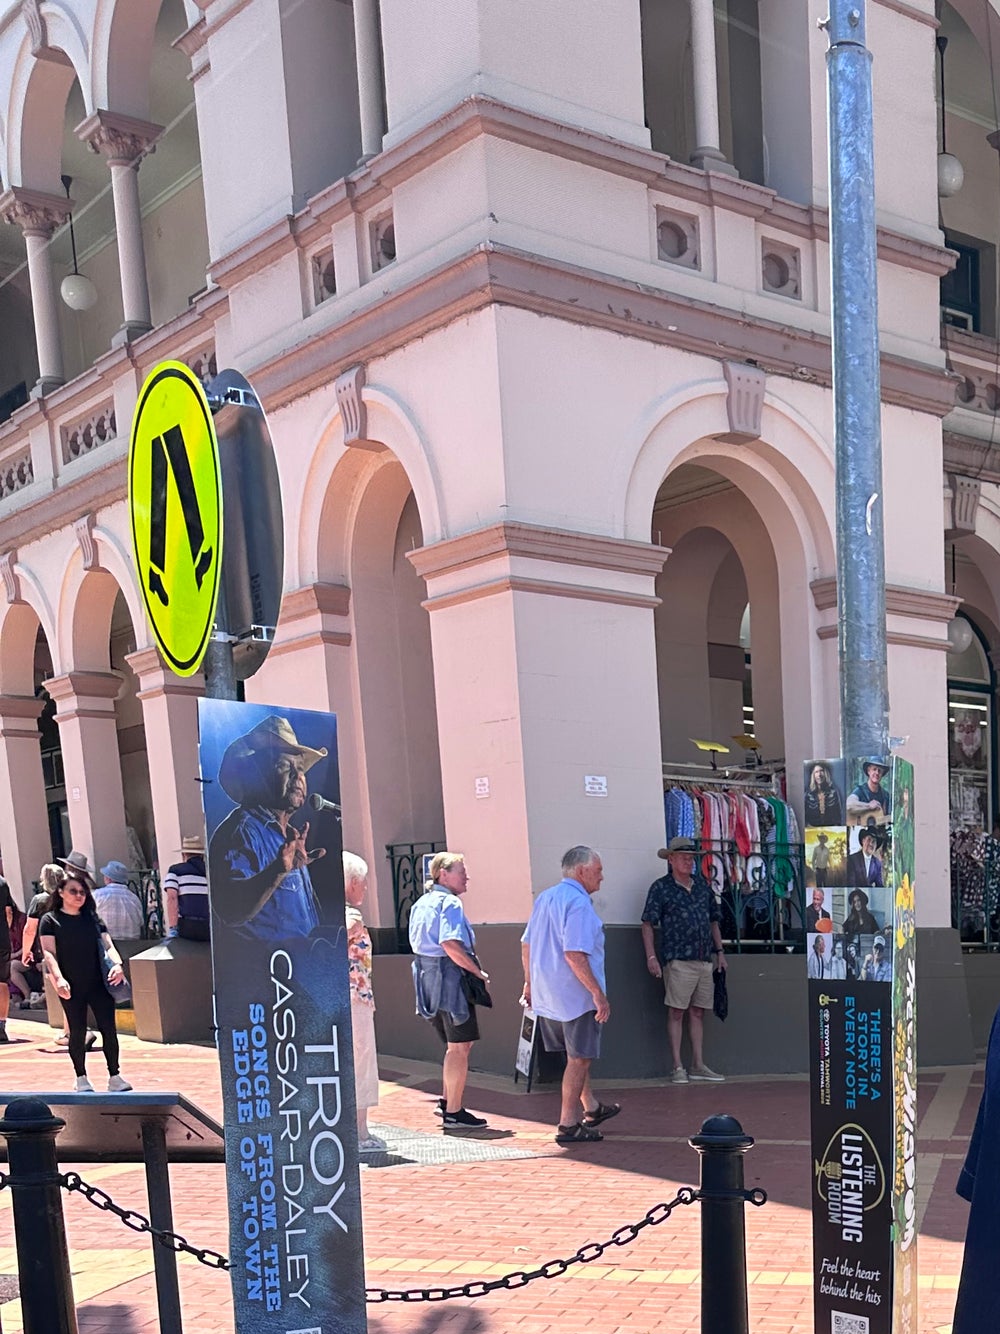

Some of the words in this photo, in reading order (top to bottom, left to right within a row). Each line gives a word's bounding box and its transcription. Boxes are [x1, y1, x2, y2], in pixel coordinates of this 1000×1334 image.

[845, 996, 856, 1058] EVERY
[857, 1011, 868, 1073] STORY
[870, 1008, 881, 1084] THERE'S
[231, 1028, 254, 1124] EDGE
[249, 1002, 270, 1120] SONGS
[845, 1060, 856, 1110] NOTE
[858, 1076, 868, 1096] IN
[870, 1087, 881, 1101] A
[269, 948, 312, 1309] CASSAR-DALEY
[303, 1024, 348, 1234] TROY
[240, 1138, 257, 1182] OF
[257, 1132, 278, 1232] FROM
[841, 1133, 863, 1243] LISTENING
[864, 1163, 876, 1186] THE
[827, 1181, 842, 1225] ROOM
[242, 1201, 263, 1302] TOWN
[267, 1244, 283, 1313] THE
[820, 1257, 840, 1275] Feel
[841, 1263, 854, 1277] the
[855, 1261, 881, 1282] heart
[820, 1277, 848, 1299] behind
[850, 1284, 864, 1302] the
[865, 1286, 882, 1306] hits
